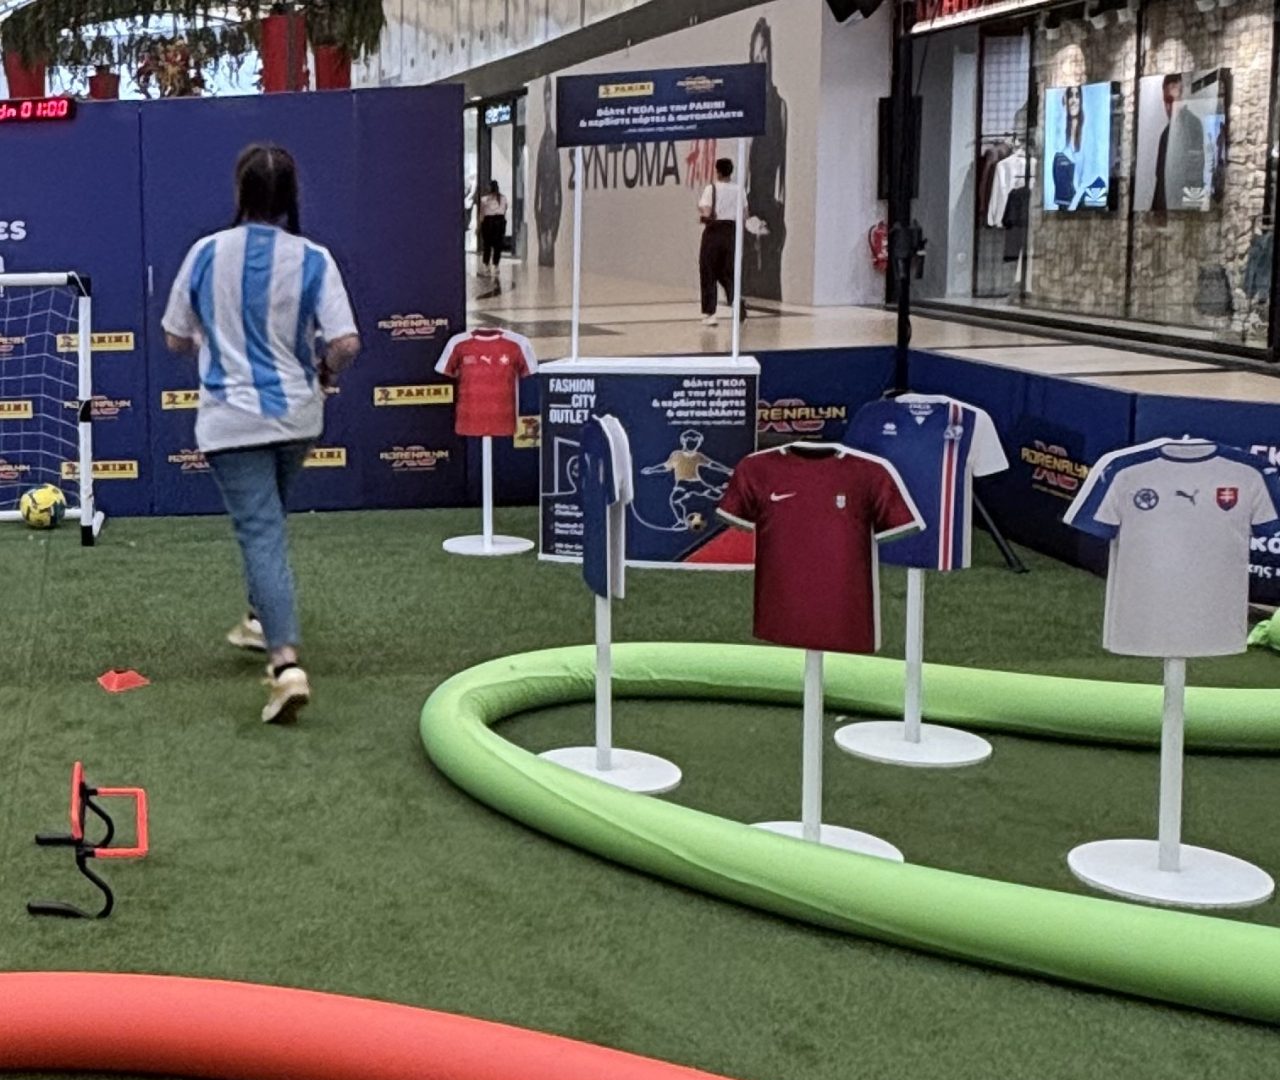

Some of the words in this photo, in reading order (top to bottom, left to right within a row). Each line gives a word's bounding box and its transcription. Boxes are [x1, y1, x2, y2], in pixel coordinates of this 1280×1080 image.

[549, 378, 594, 392] FASHION
[572, 394, 596, 408] CITY
[549, 409, 589, 424] OUTLET
[758, 406, 846, 421] RENALYN
